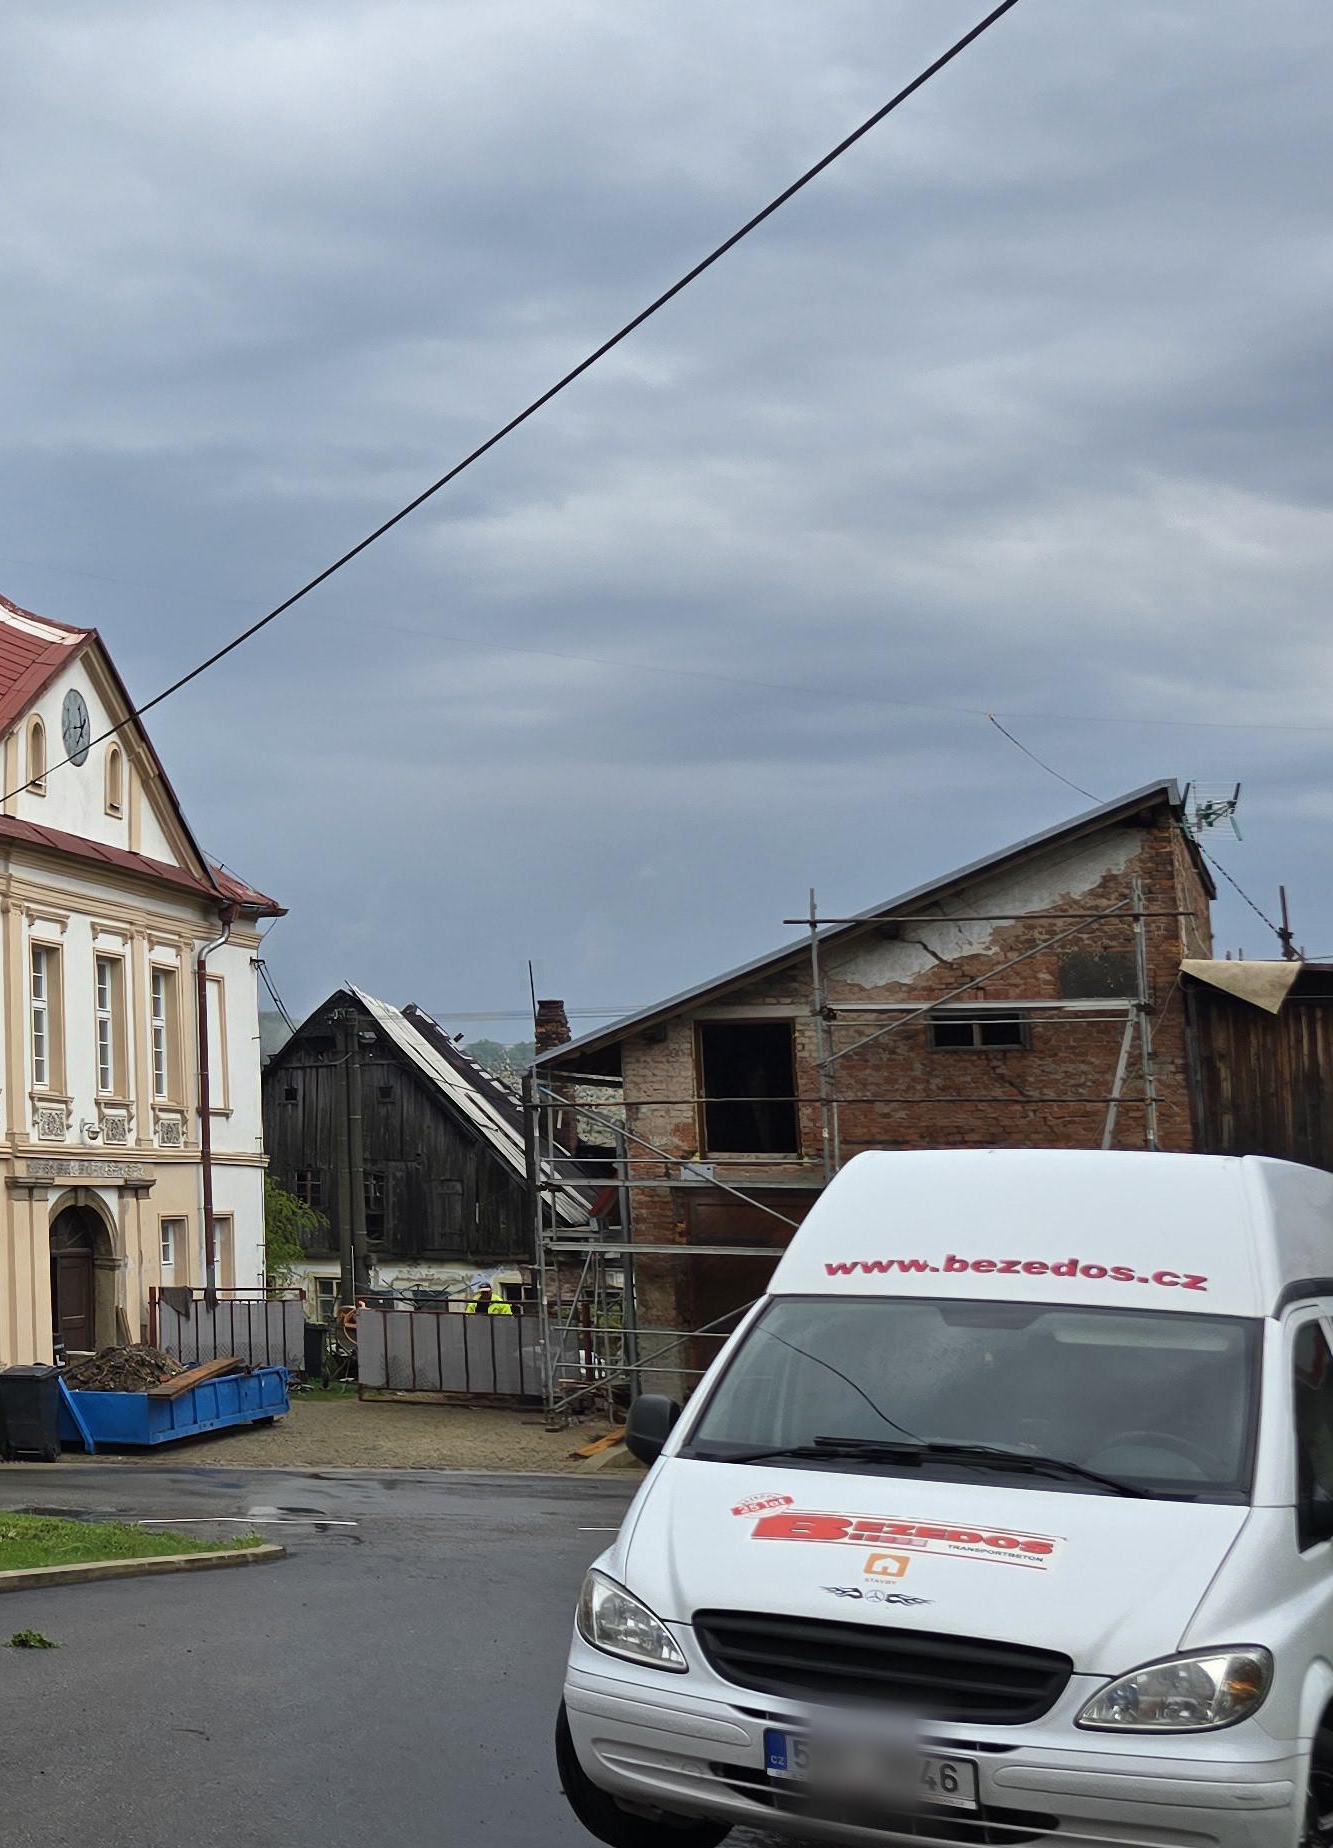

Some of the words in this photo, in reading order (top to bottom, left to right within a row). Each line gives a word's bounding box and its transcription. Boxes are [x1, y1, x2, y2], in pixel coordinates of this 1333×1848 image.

[824, 1254, 1208, 1292] www.bezedos.cz
[751, 1514, 1054, 1555] BEZEDOS
[948, 1544, 1043, 1562] TRANSPORTBETON
[770, 1755, 784, 1766] CZ
